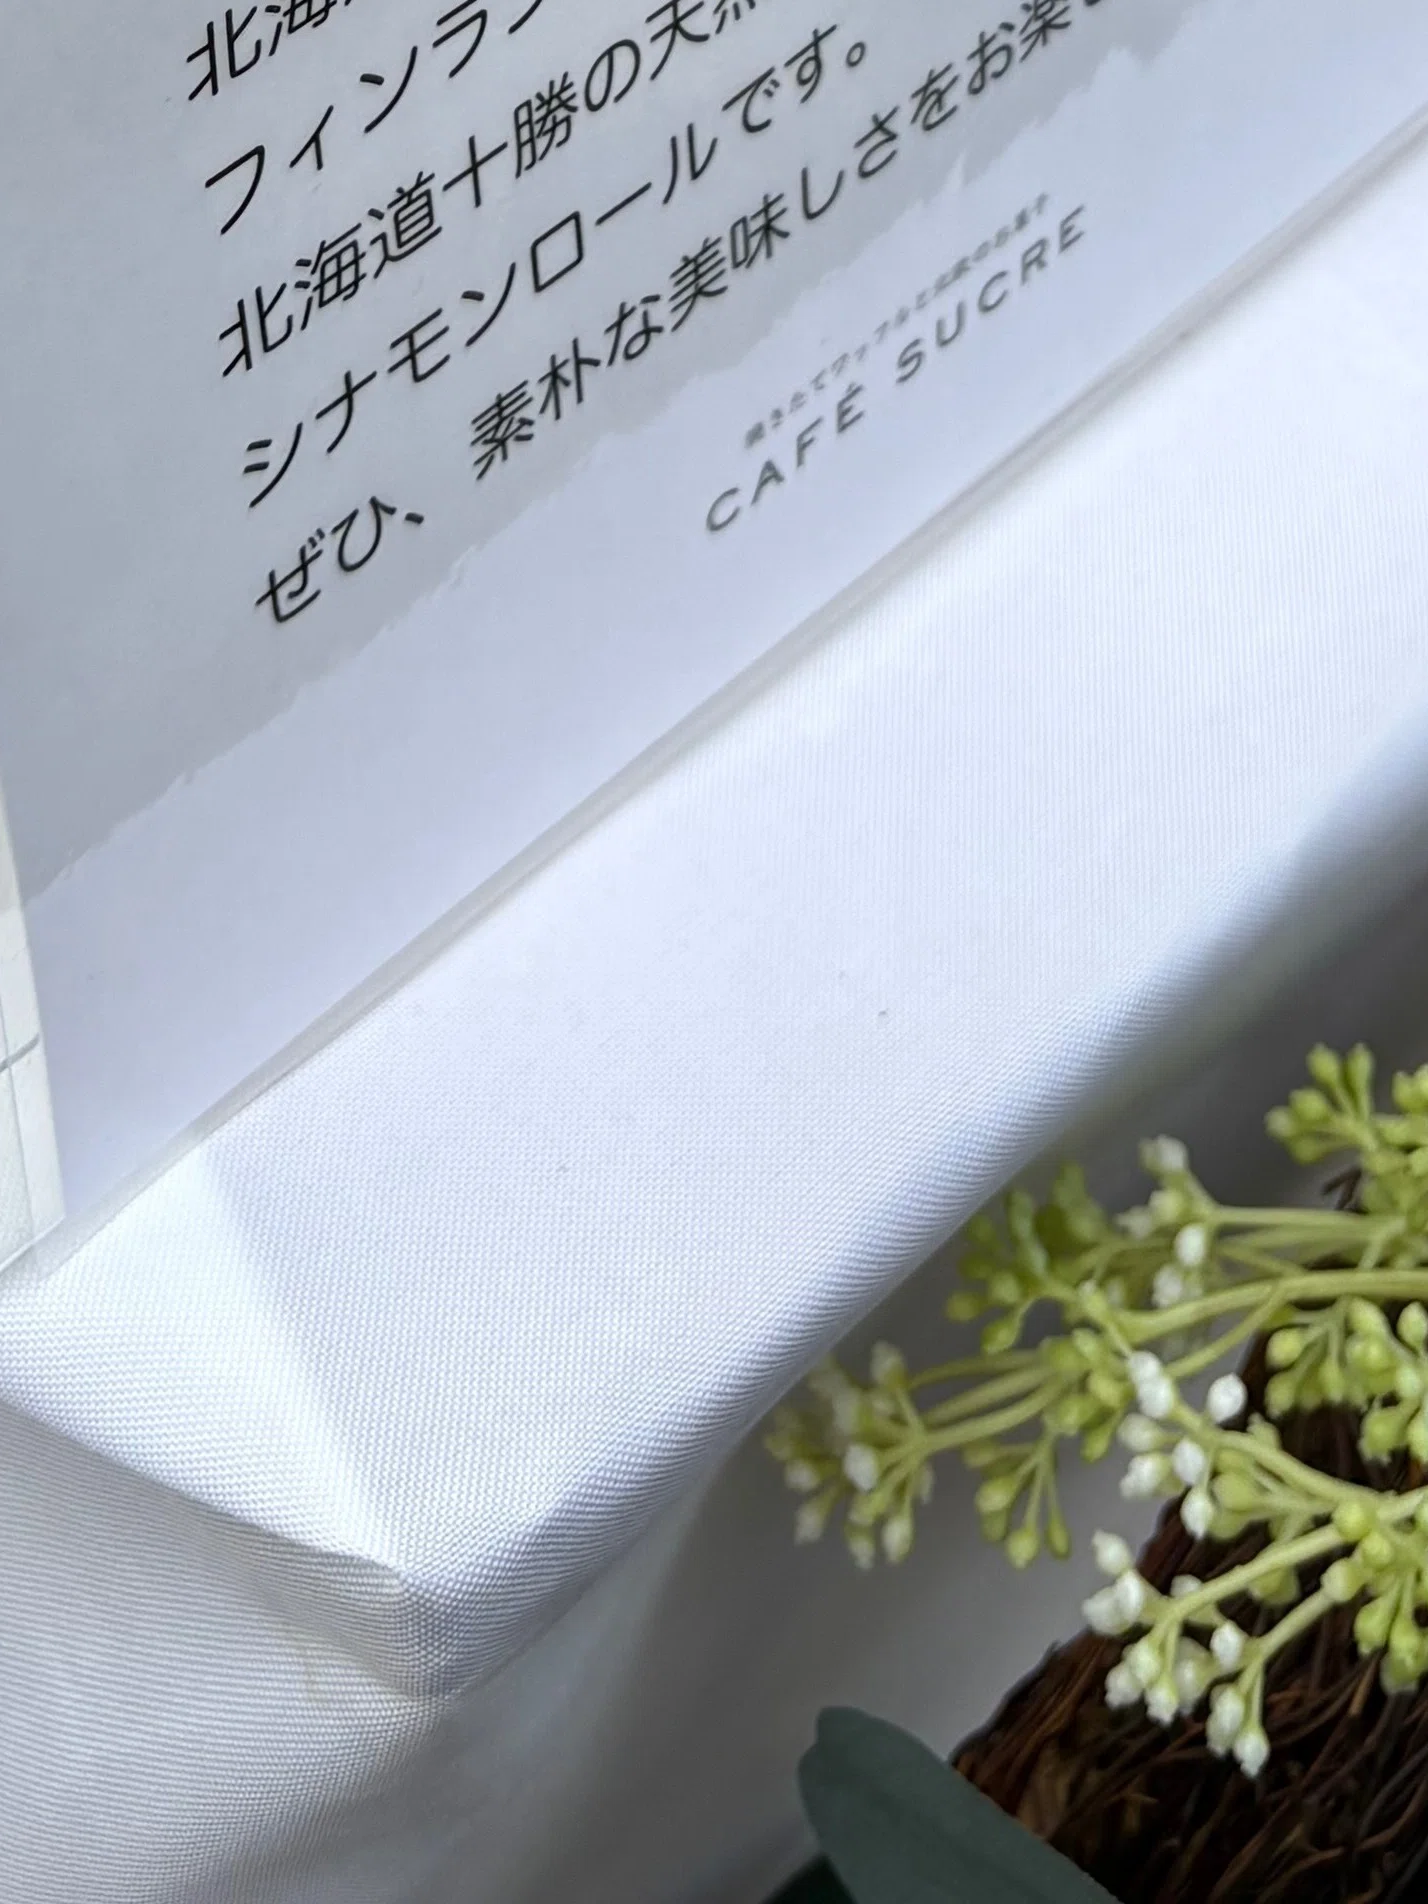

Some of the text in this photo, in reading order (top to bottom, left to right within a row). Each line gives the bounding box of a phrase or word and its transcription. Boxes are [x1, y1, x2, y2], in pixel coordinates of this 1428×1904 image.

[242, 24, 866, 510] シナモンロールです。
[895, 204, 1086, 384] SUCRE
